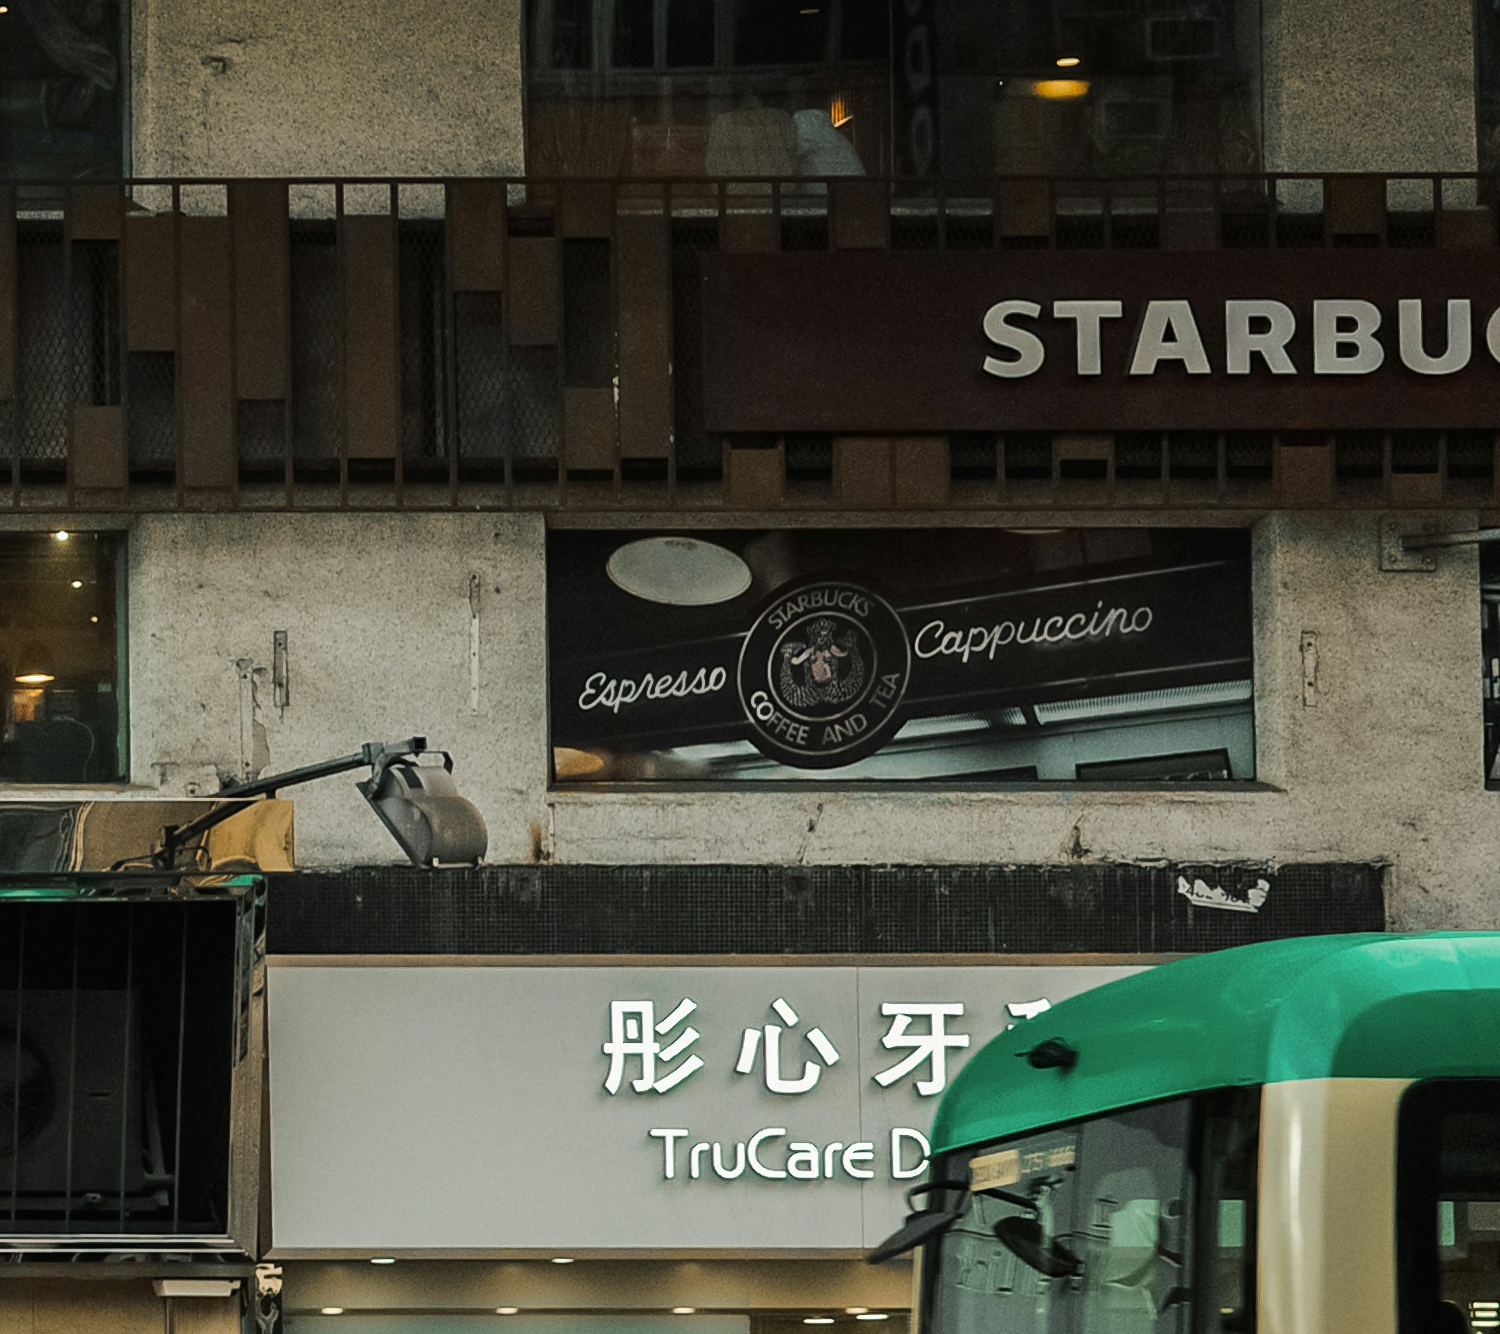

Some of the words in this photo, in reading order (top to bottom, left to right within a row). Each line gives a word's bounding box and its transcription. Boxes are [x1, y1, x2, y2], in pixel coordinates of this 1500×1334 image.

[982, 298, 1500, 381] STARBU
[767, 589, 874, 632] STARBUCKS
[914, 600, 1154, 665] Cappuccino
[578, 666, 727, 714] Espresso
[748, 689, 810, 747] COFFEE
[821, 712, 869, 747] AND
[870, 671, 902, 711] TEA
[649, 1127, 874, 1180] TruCare
